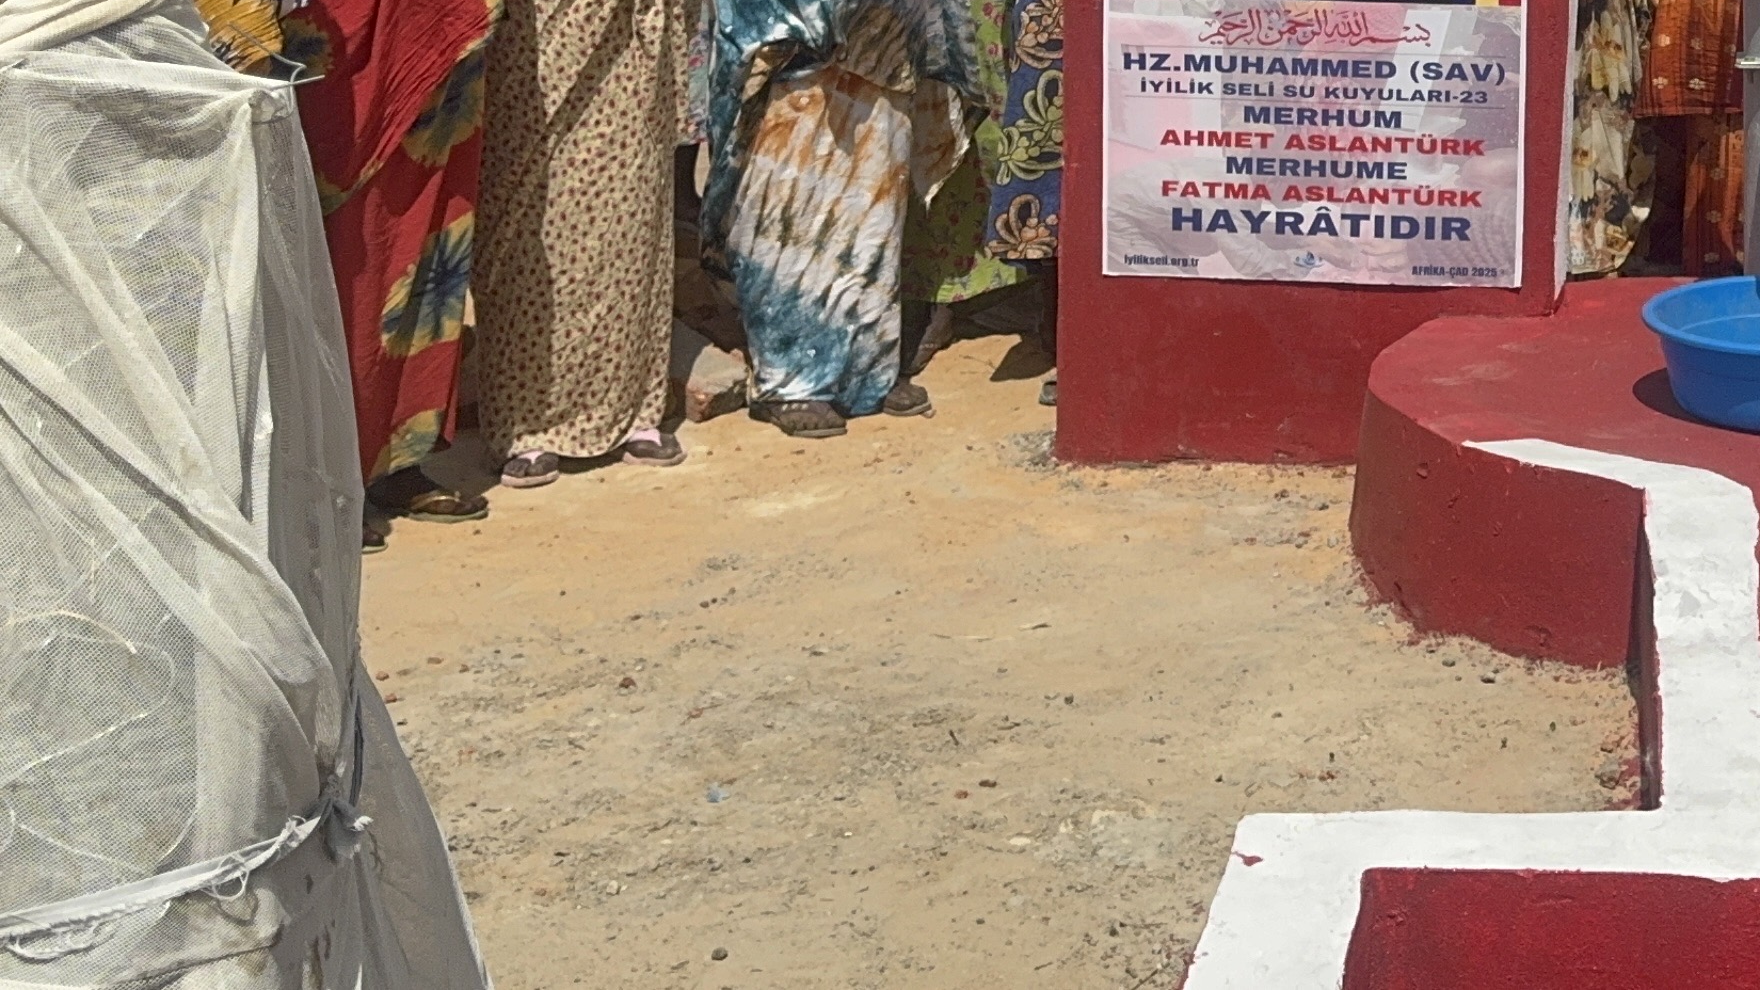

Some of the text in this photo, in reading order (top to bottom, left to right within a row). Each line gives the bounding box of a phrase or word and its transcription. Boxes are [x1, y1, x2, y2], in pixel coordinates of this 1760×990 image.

[1123, 52, 1506, 86] HZ.MUHAMMED (SAV)
[1140, 77, 1488, 104] İYİLİK SELİ SU KUYULARI-23
[1243, 105, 1403, 129] MERHUM
[1160, 129, 1486, 156] AHMET ASLANTÜRK
[1226, 156, 1408, 180] MERHUME
[1161, 180, 1483, 208] FATMA ASLANTÜRK
[1171, 206, 1471, 241] HAYRÂTIDIR
[1471, 267, 1498, 278] 2025
